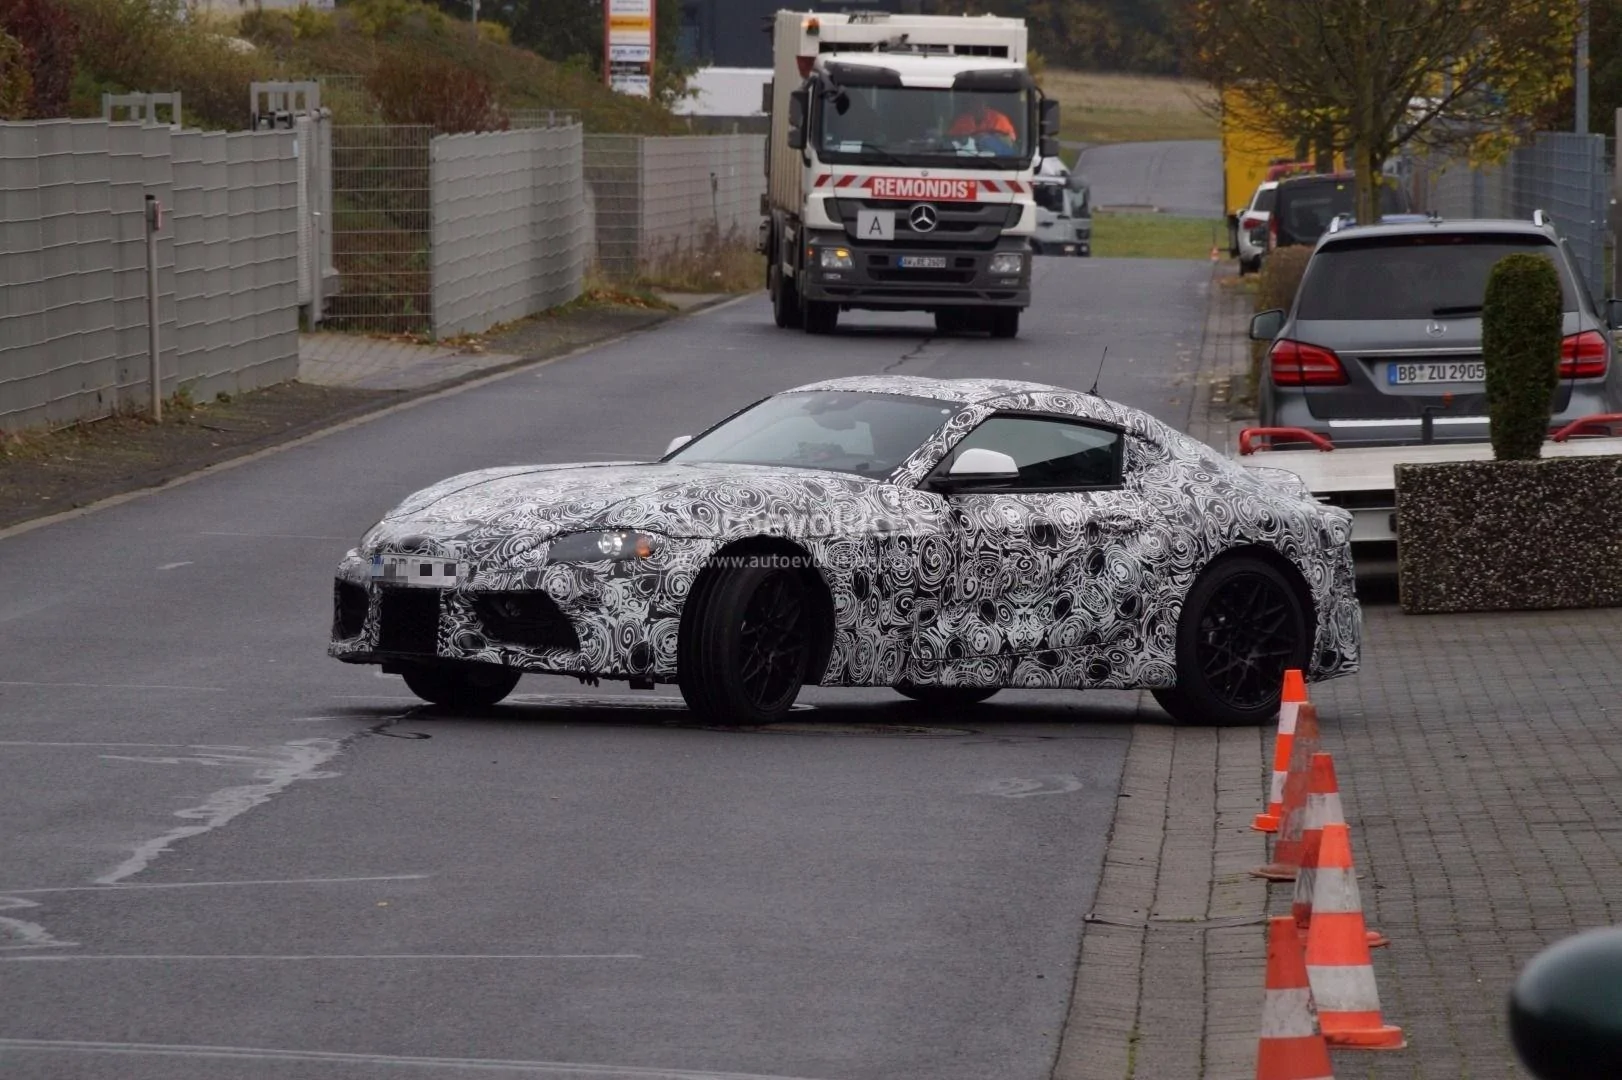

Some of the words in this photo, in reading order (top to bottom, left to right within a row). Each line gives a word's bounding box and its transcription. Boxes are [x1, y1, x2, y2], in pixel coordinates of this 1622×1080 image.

[868, 215, 883, 236] A
[1398, 366, 1417, 381] BB
[1428, 365, 1446, 380] ZU
[1449, 364, 1485, 380] 2905
